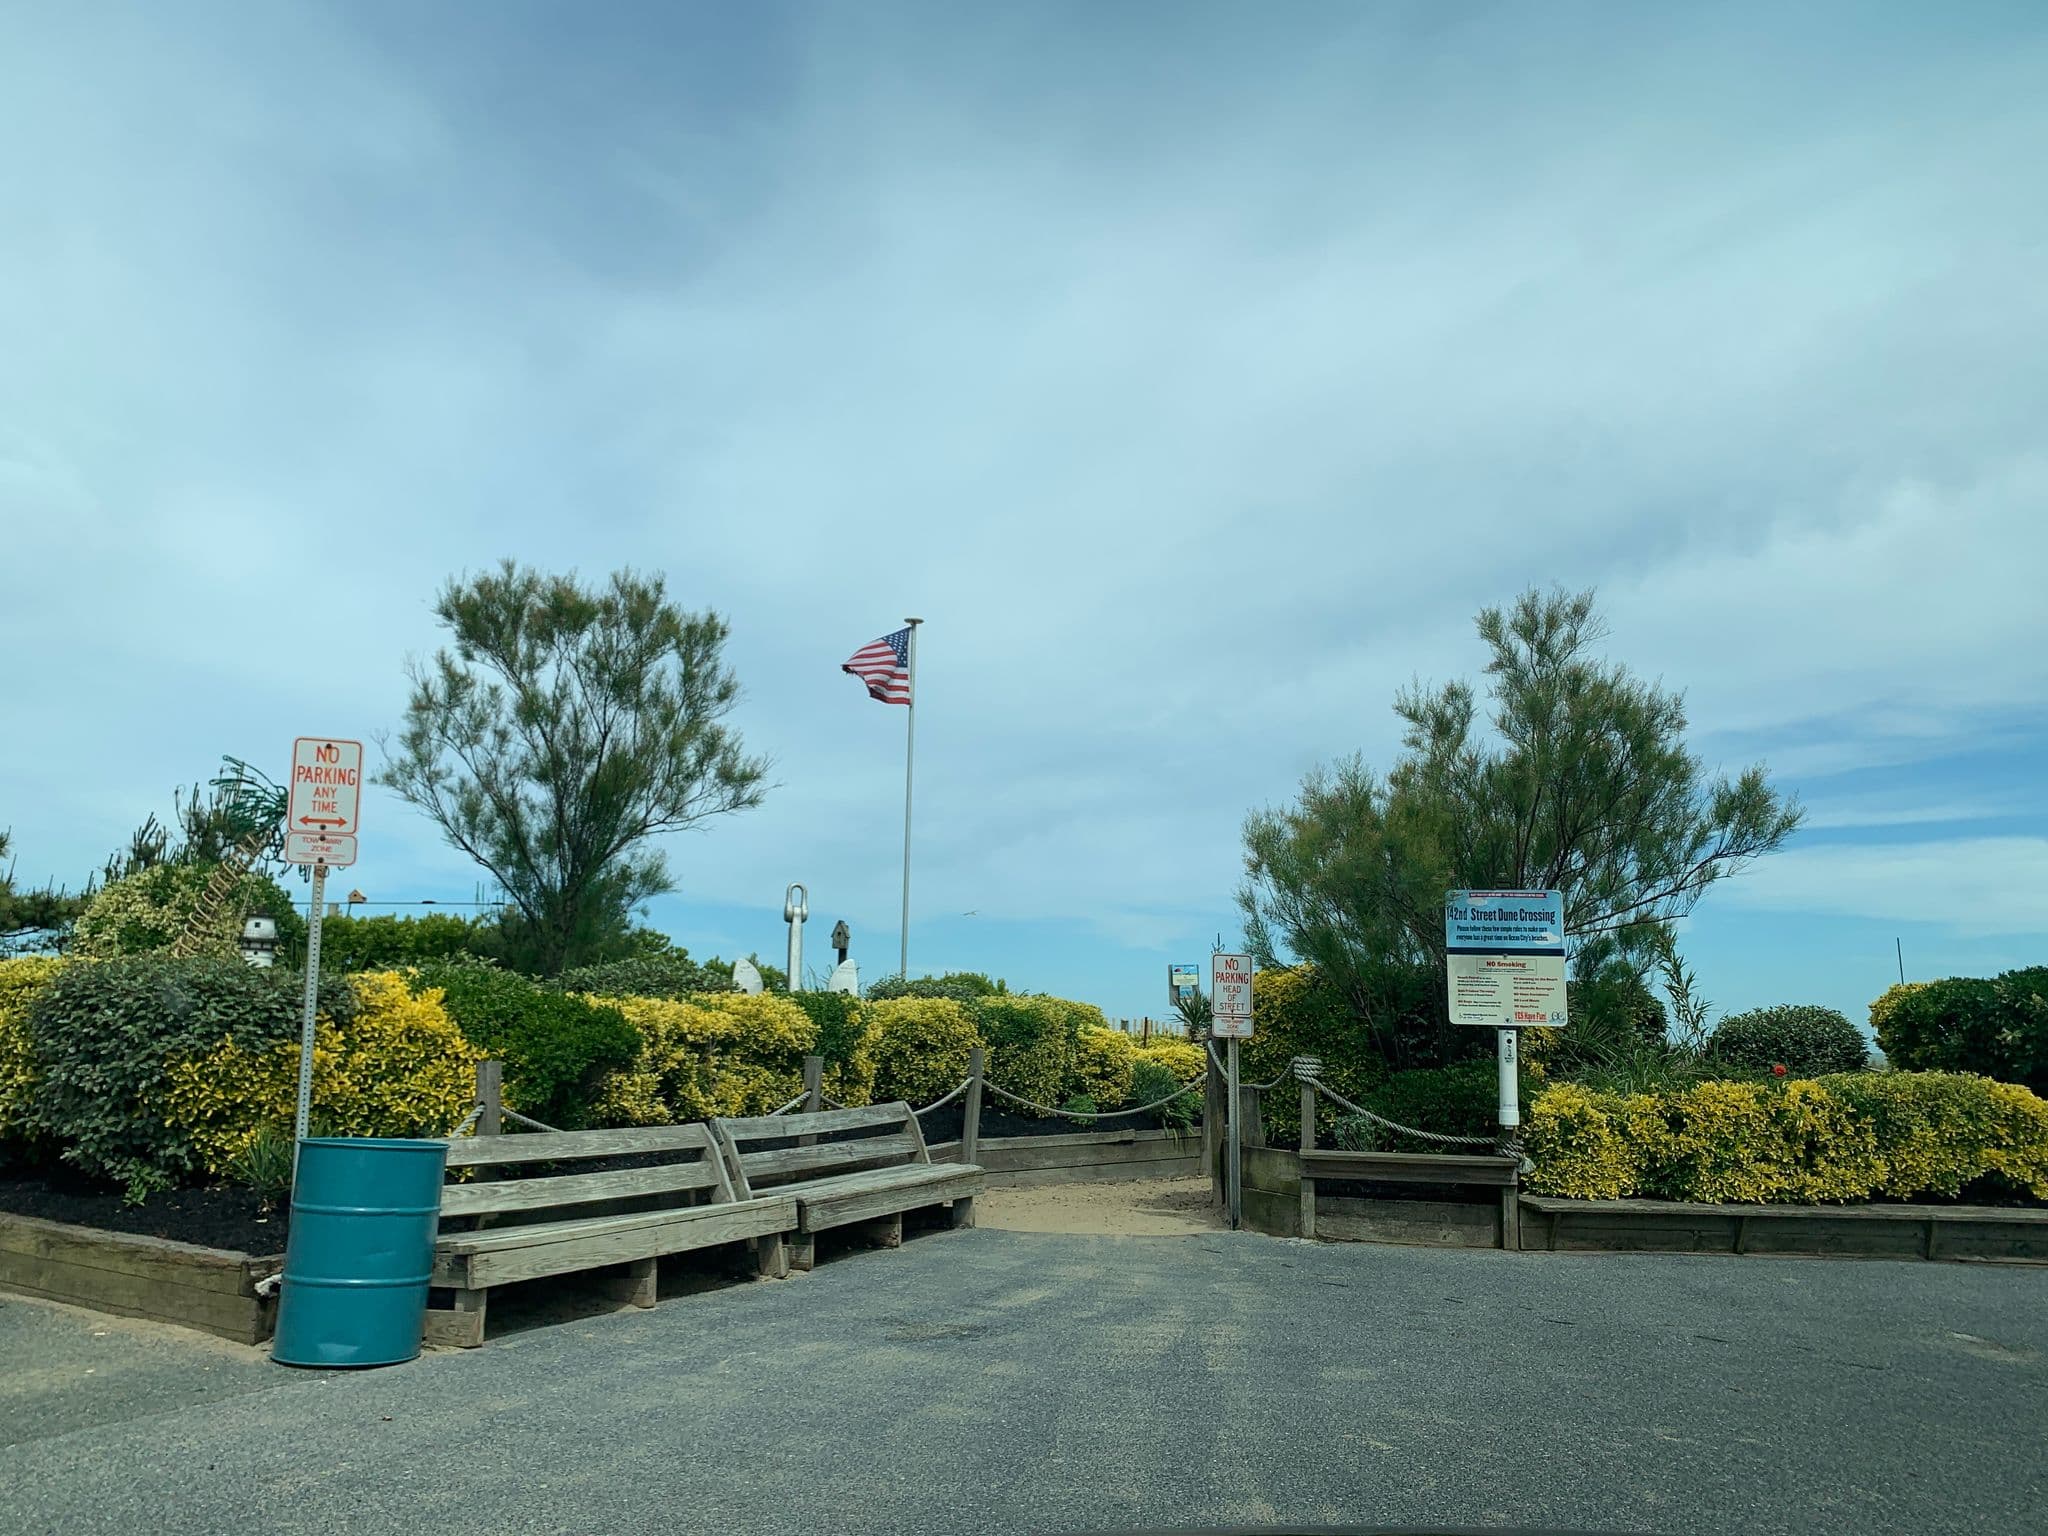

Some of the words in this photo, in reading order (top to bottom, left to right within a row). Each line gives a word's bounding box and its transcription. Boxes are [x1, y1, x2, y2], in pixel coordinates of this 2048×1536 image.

[316, 746, 340, 763] NO
[297, 765, 356, 786] PARKING
[313, 786, 337, 799] ANY
[312, 800, 338, 813] TIME
[1446, 906, 1468, 920] 142nd
[1470, 907, 1496, 921] Street
[1498, 908, 1518, 921] Dune
[1520, 908, 1556, 925] Crossing
[1225, 960, 1239, 971] NO
[1216, 972, 1249, 984] PARKING
[1223, 985, 1241, 993] HEAD
[1228, 994, 1237, 1002] OF
[1220, 1003, 1245, 1011] STREET
